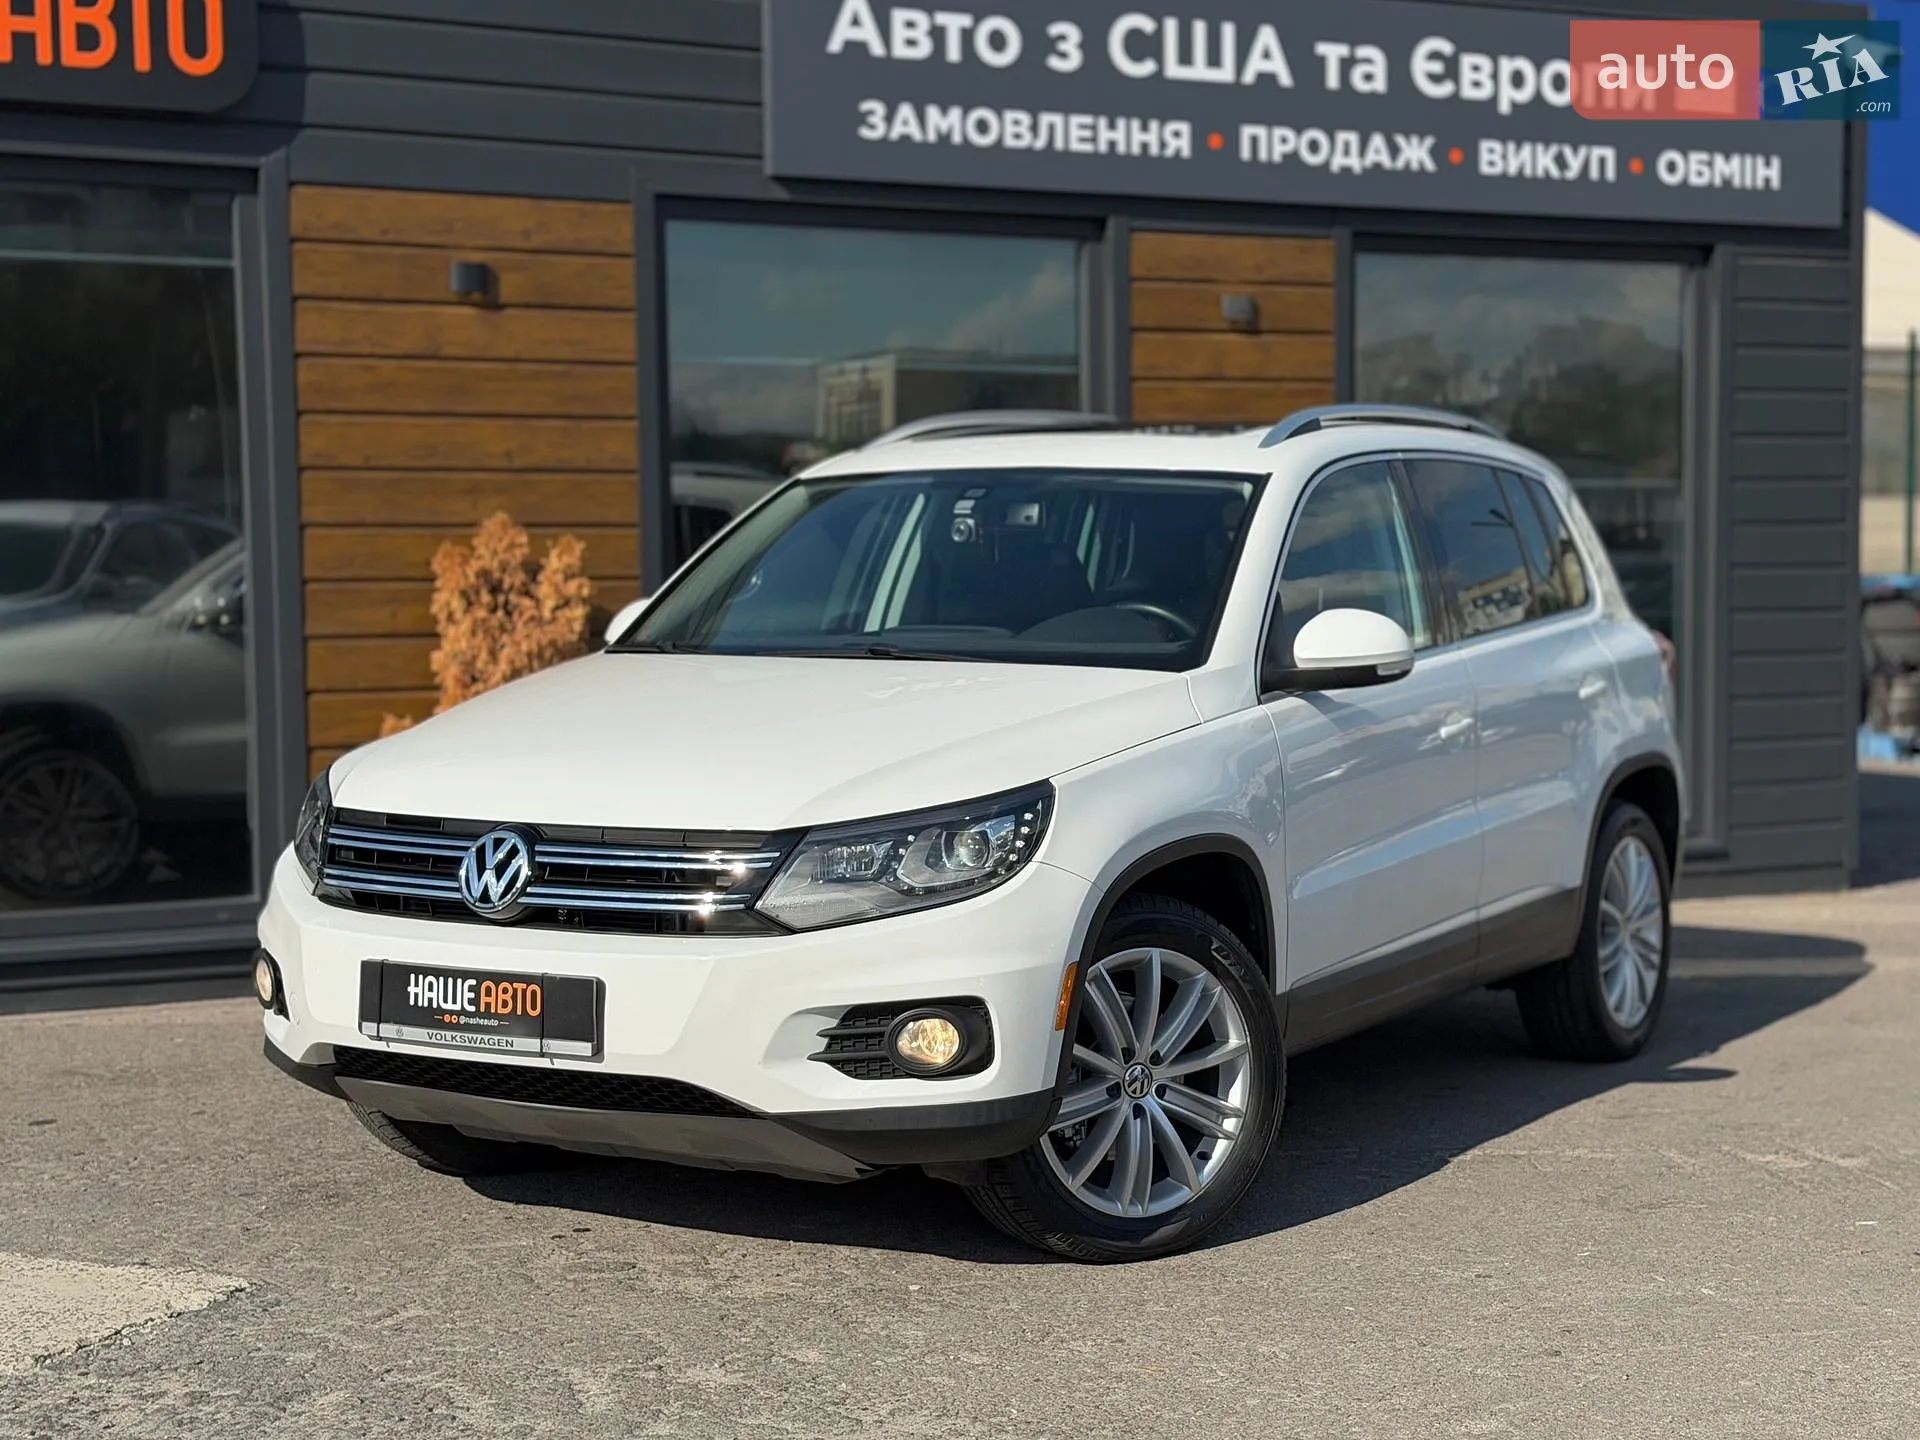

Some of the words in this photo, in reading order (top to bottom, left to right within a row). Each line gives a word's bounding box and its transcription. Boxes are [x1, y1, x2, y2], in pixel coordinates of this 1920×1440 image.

[826, 0, 1023, 68] Авто
[1045, 22, 1084, 73] з
[1107, 13, 1295, 88] США
[1314, 40, 1389, 94] та
[857, 99, 1192, 159] ЗАМОВЛЕННЯ
[1239, 123, 1437, 174] ПРОДАЖ
[1478, 138, 1617, 182] ВИКУП
[1656, 149, 1782, 190] ОБМІН
[407, 973, 477, 1013] НАШЕ
[479, 980, 543, 1017] АВТО
[426, 1031, 515, 1049] VOLKSWAGEN
